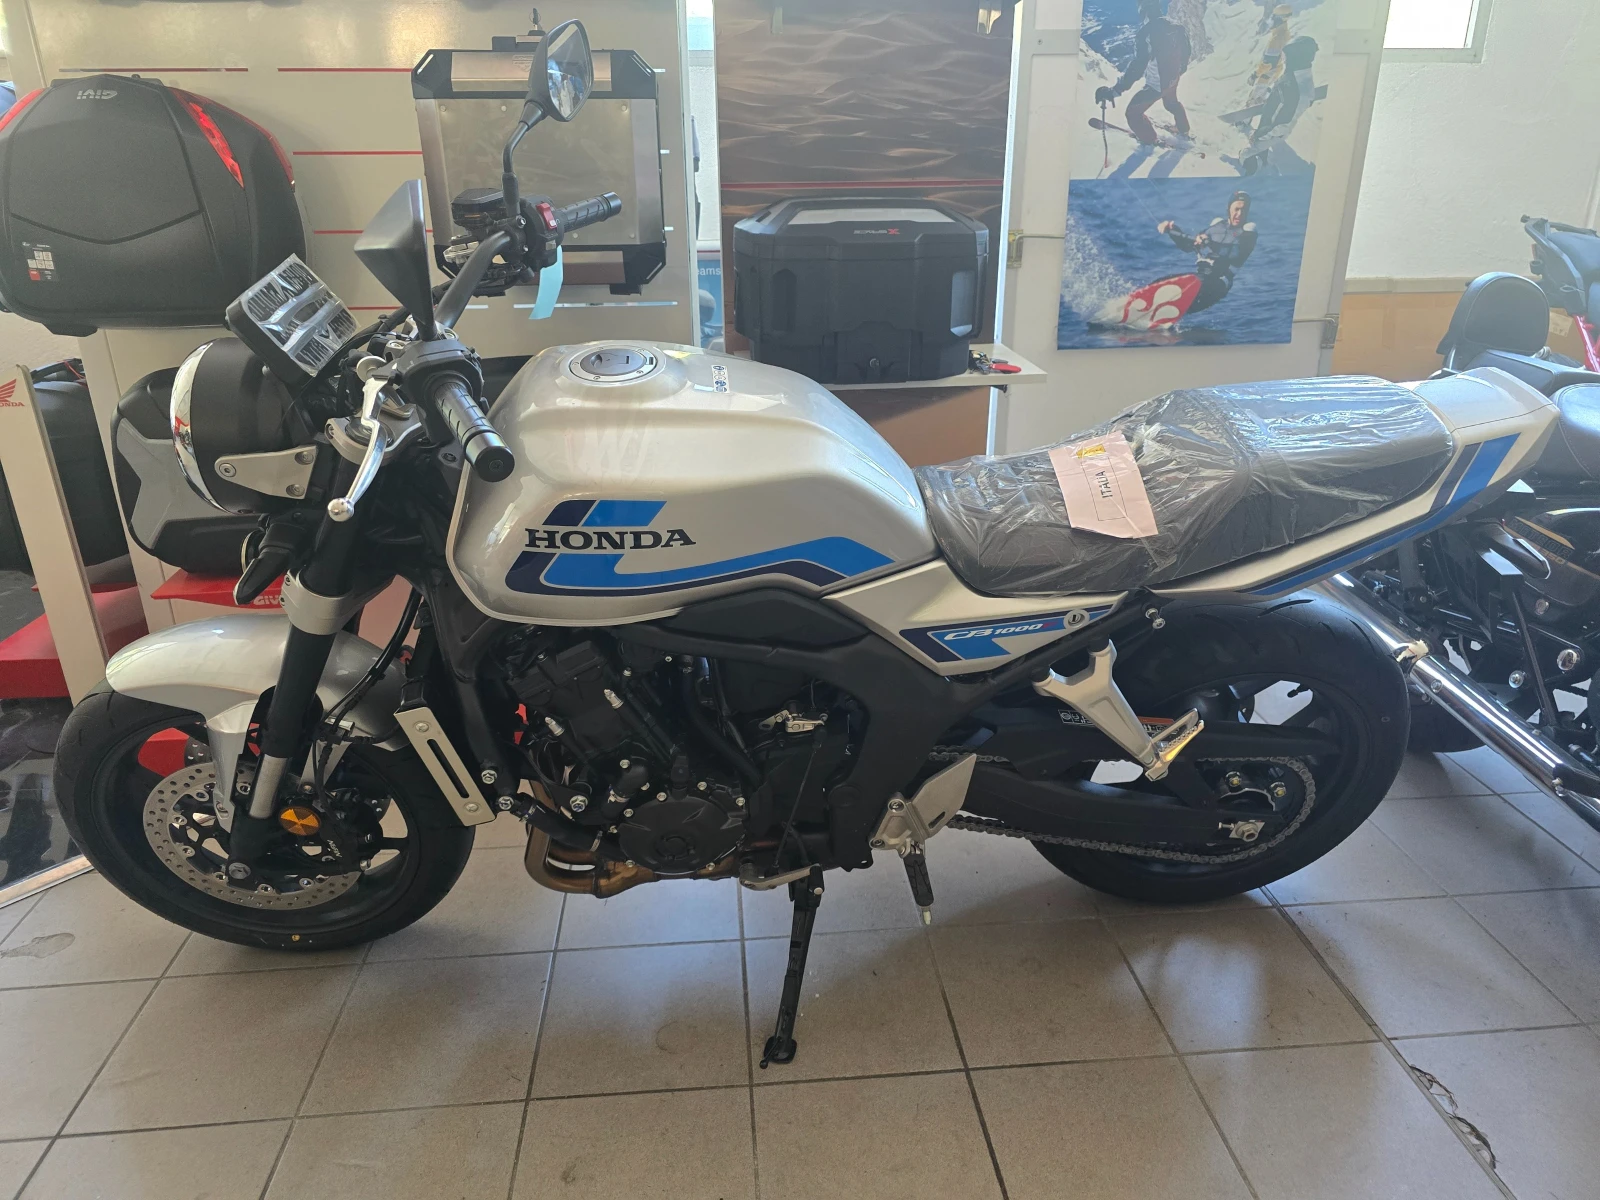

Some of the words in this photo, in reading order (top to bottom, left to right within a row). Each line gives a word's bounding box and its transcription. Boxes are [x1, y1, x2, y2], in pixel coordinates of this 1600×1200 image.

[1095, 470, 1113, 499] ITALIA
[524, 528, 697, 550] HONDA
[253, 595, 280, 606] GIV
